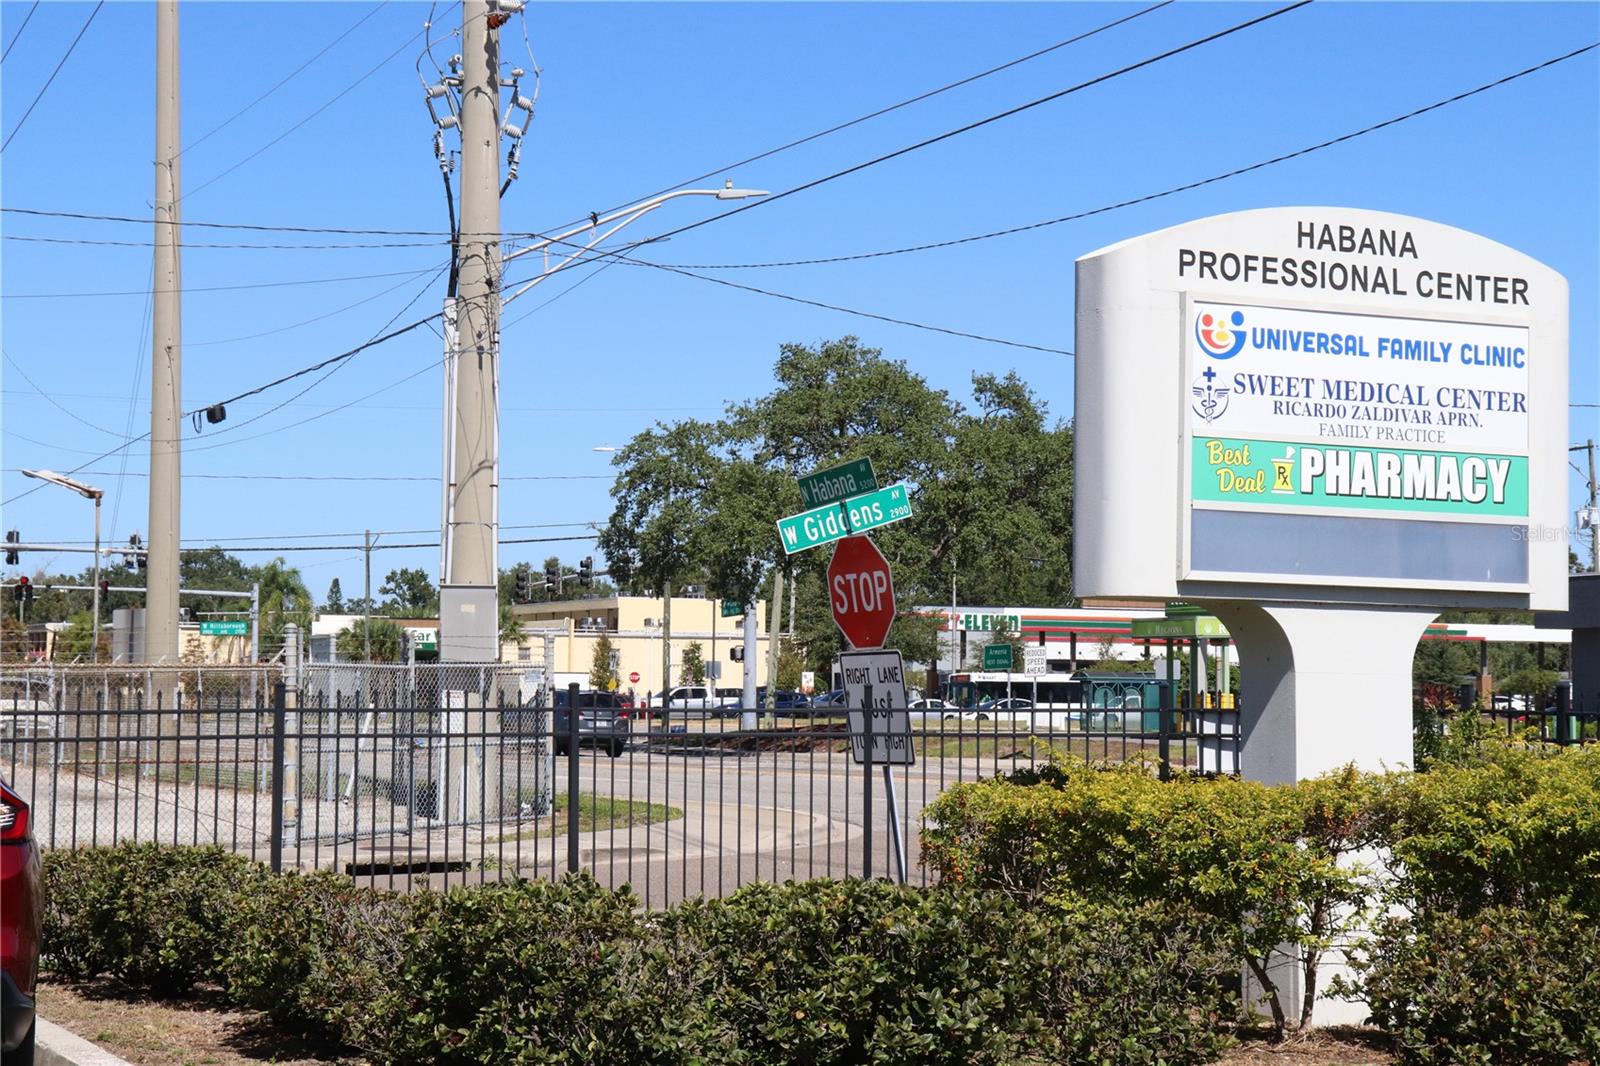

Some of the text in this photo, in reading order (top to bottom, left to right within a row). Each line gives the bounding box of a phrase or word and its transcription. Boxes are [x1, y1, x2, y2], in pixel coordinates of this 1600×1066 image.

[1297, 221, 1418, 259] HABANA
[1178, 248, 1530, 306] PROFESSIONAL CENTER
[1252, 327, 1525, 369] UNIVERSAL FAMILY CLINIC
[1233, 373, 1527, 413] SWEET MEDICAL CENTER
[1273, 400, 1483, 428] RICARDO ZALDIVAR APRN.
[1319, 423, 1445, 444] FAMILY PRACTICE
[1205, 440, 1251, 466] Best
[809, 473, 857, 503] Habana
[1215, 467, 1266, 493] Deal
[1300, 447, 1512, 504] PHARMACY
[891, 489, 900, 500] AV
[783, 502, 909, 545] W Giddens 2900
[834, 570, 888, 614] STOP
[845, 666, 900, 685] RIGHT LANE
[1027, 657, 1045, 666] SPEED
